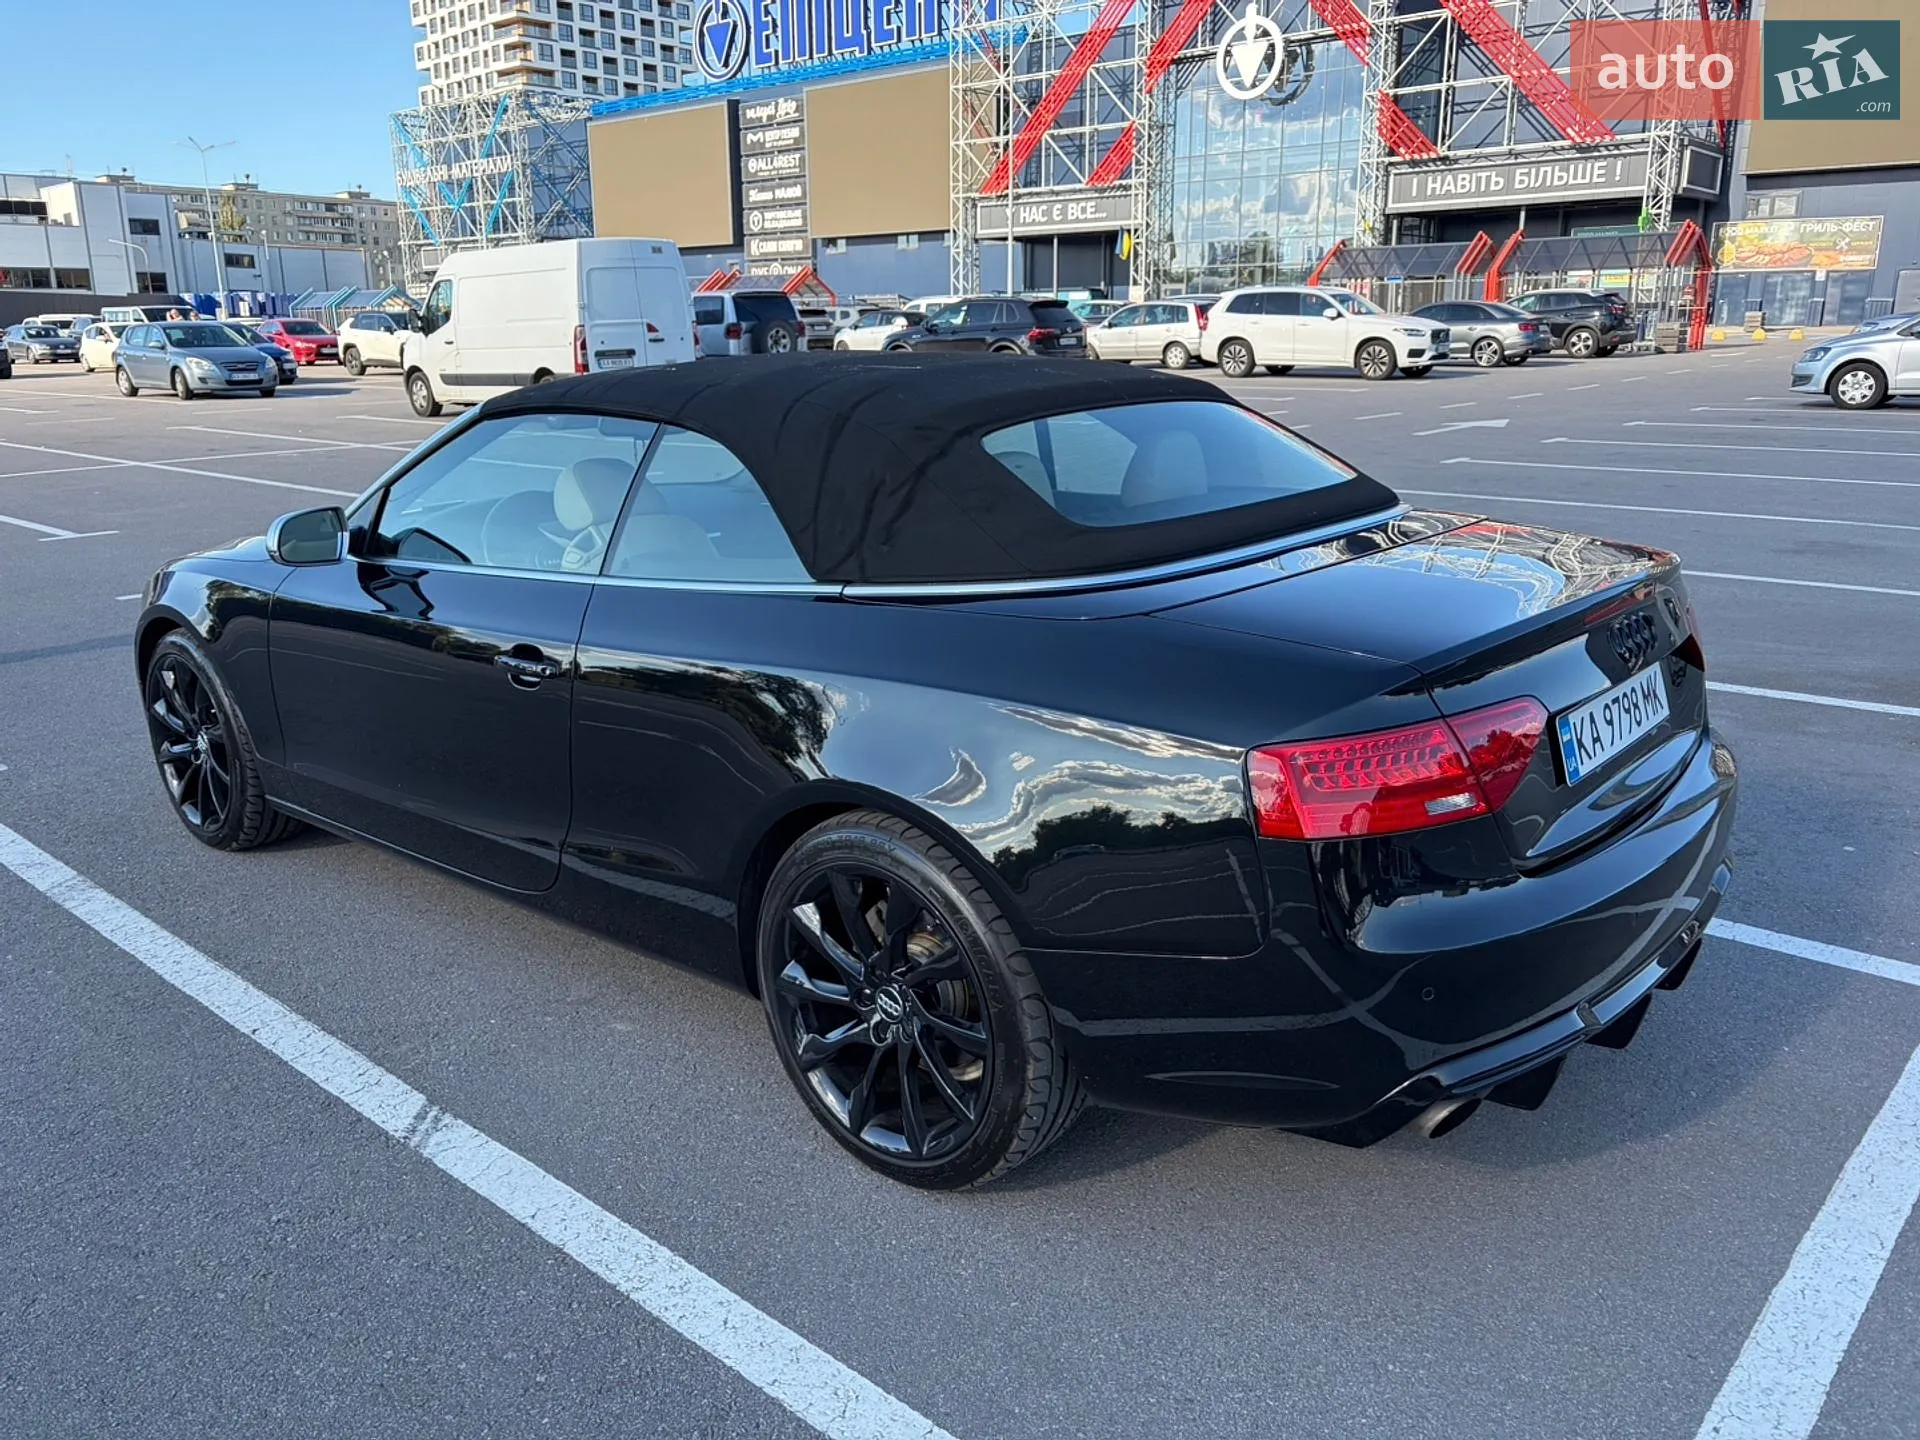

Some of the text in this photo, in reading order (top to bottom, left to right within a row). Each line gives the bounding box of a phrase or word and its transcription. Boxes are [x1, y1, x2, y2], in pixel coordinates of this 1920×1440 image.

[1427, 171, 1505, 197] НАВІТЬ
[1514, 162, 1607, 190] БІЛЬШЕ
[1020, 205, 1048, 223] НАС
[1052, 203, 1063, 220] Є
[1800, 220, 1876, 233] ГРИЛЬ-ФЕСТ
[1573, 670, 1664, 766] KA 9798 MK
